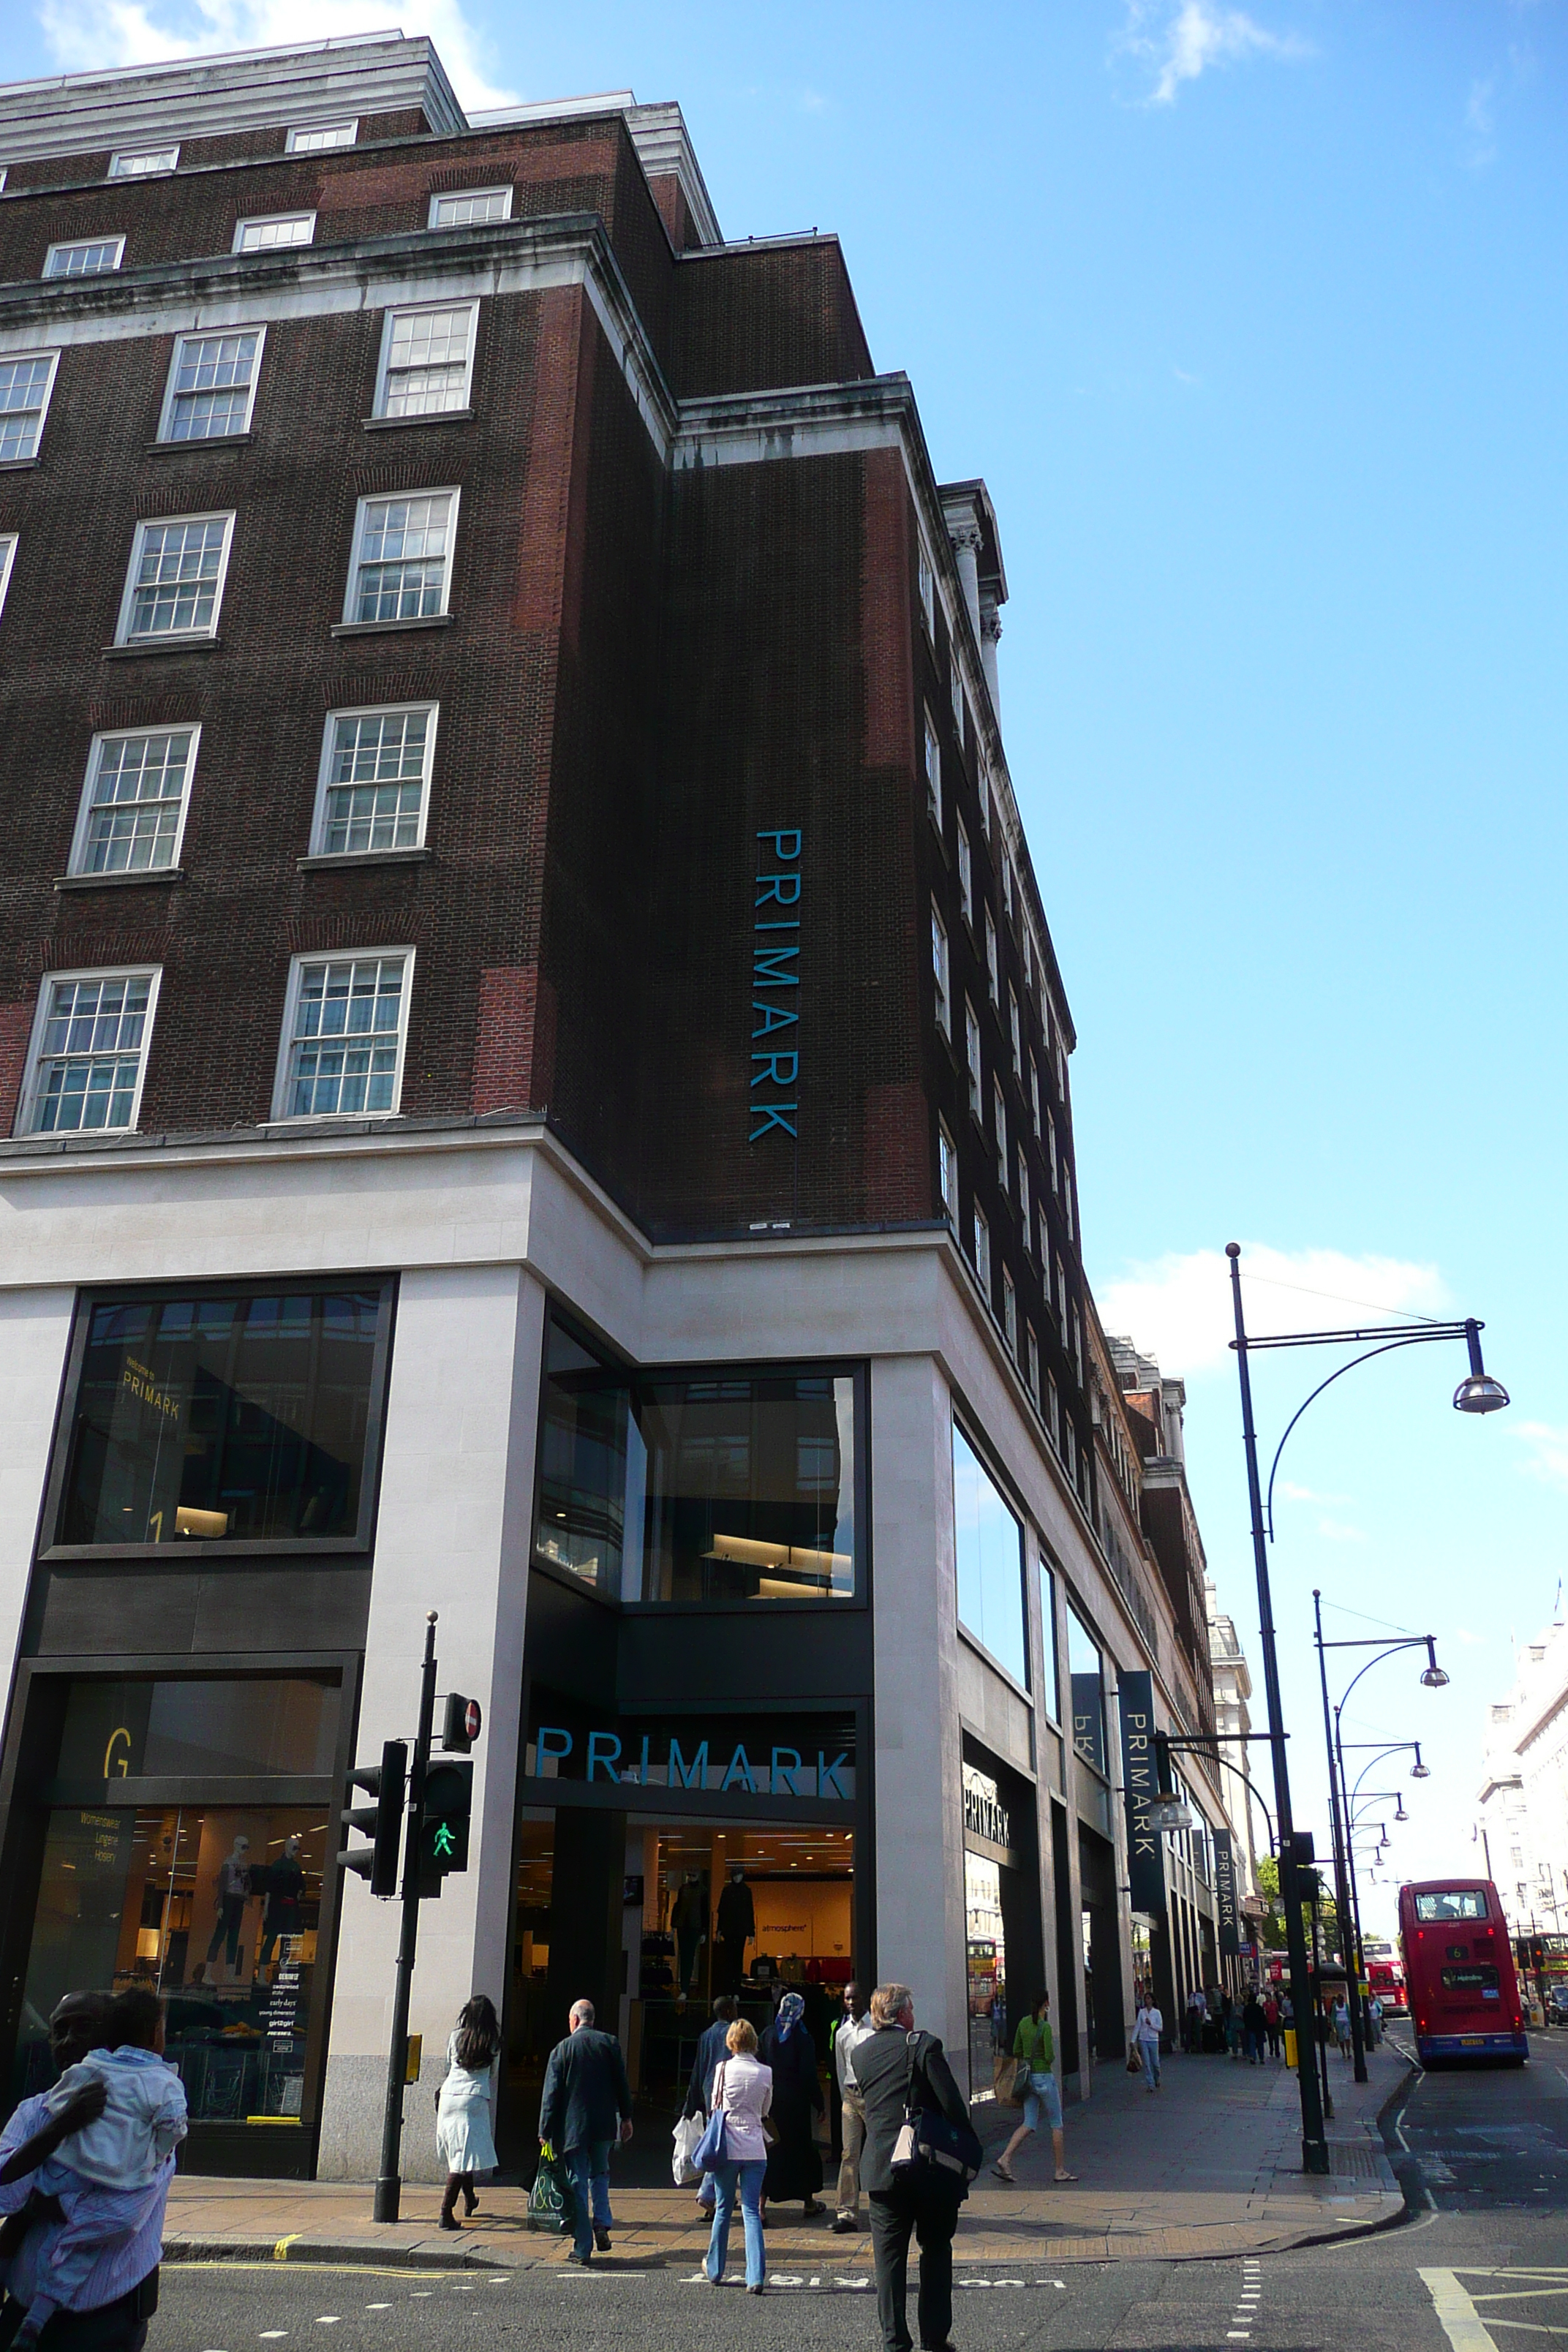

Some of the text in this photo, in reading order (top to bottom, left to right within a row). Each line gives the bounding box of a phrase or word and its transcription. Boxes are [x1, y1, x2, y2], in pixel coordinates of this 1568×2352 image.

[749, 829, 802, 1142] PRIMARK
[123, 1371, 179, 1421] PRIMARK
[150, 1511, 163, 1543] 1
[535, 1726, 849, 1800] PRIMARK
[1127, 1714, 1155, 1855] PRIMARK
[964, 1787, 1010, 1848] PRIMARK
[1218, 1851, 1234, 1926] PRIMARK
[1454, 1948, 1461, 1959] 6
[269, 1998, 296, 2008] early days
